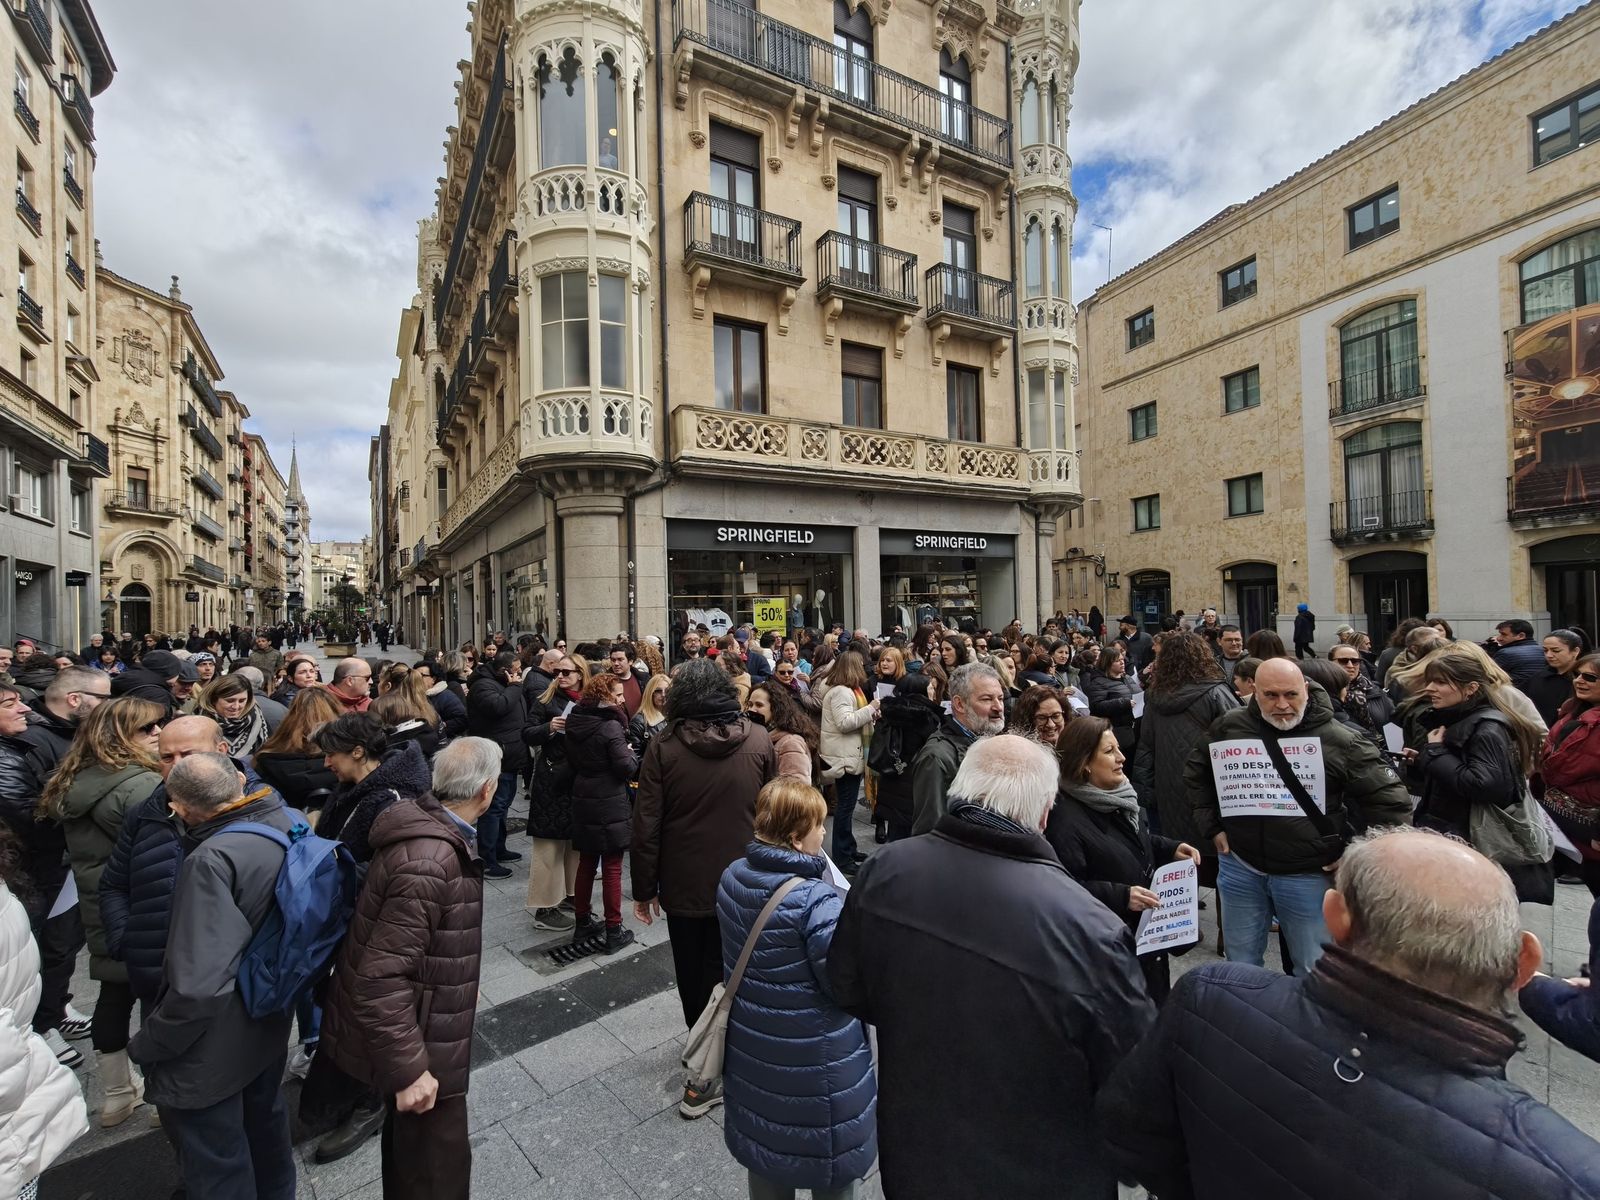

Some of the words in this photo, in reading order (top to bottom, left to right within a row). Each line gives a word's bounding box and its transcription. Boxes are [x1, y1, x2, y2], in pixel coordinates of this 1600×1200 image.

[717, 527, 815, 544] SPRINGFIELD
[915, 535, 987, 549] SPRINGFIELD
[757, 607, 783, 622] -50%
[1223, 762, 1239, 771] 169
[1242, 762, 1300, 770] DESPS
[1162, 870, 1186, 883] ERE!!
[1157, 886, 1184, 899] PIDOS
[1175, 897, 1192, 906] CALLE
[1144, 927, 1155, 936] ERE
[1166, 920, 1192, 930] MAJOREL
